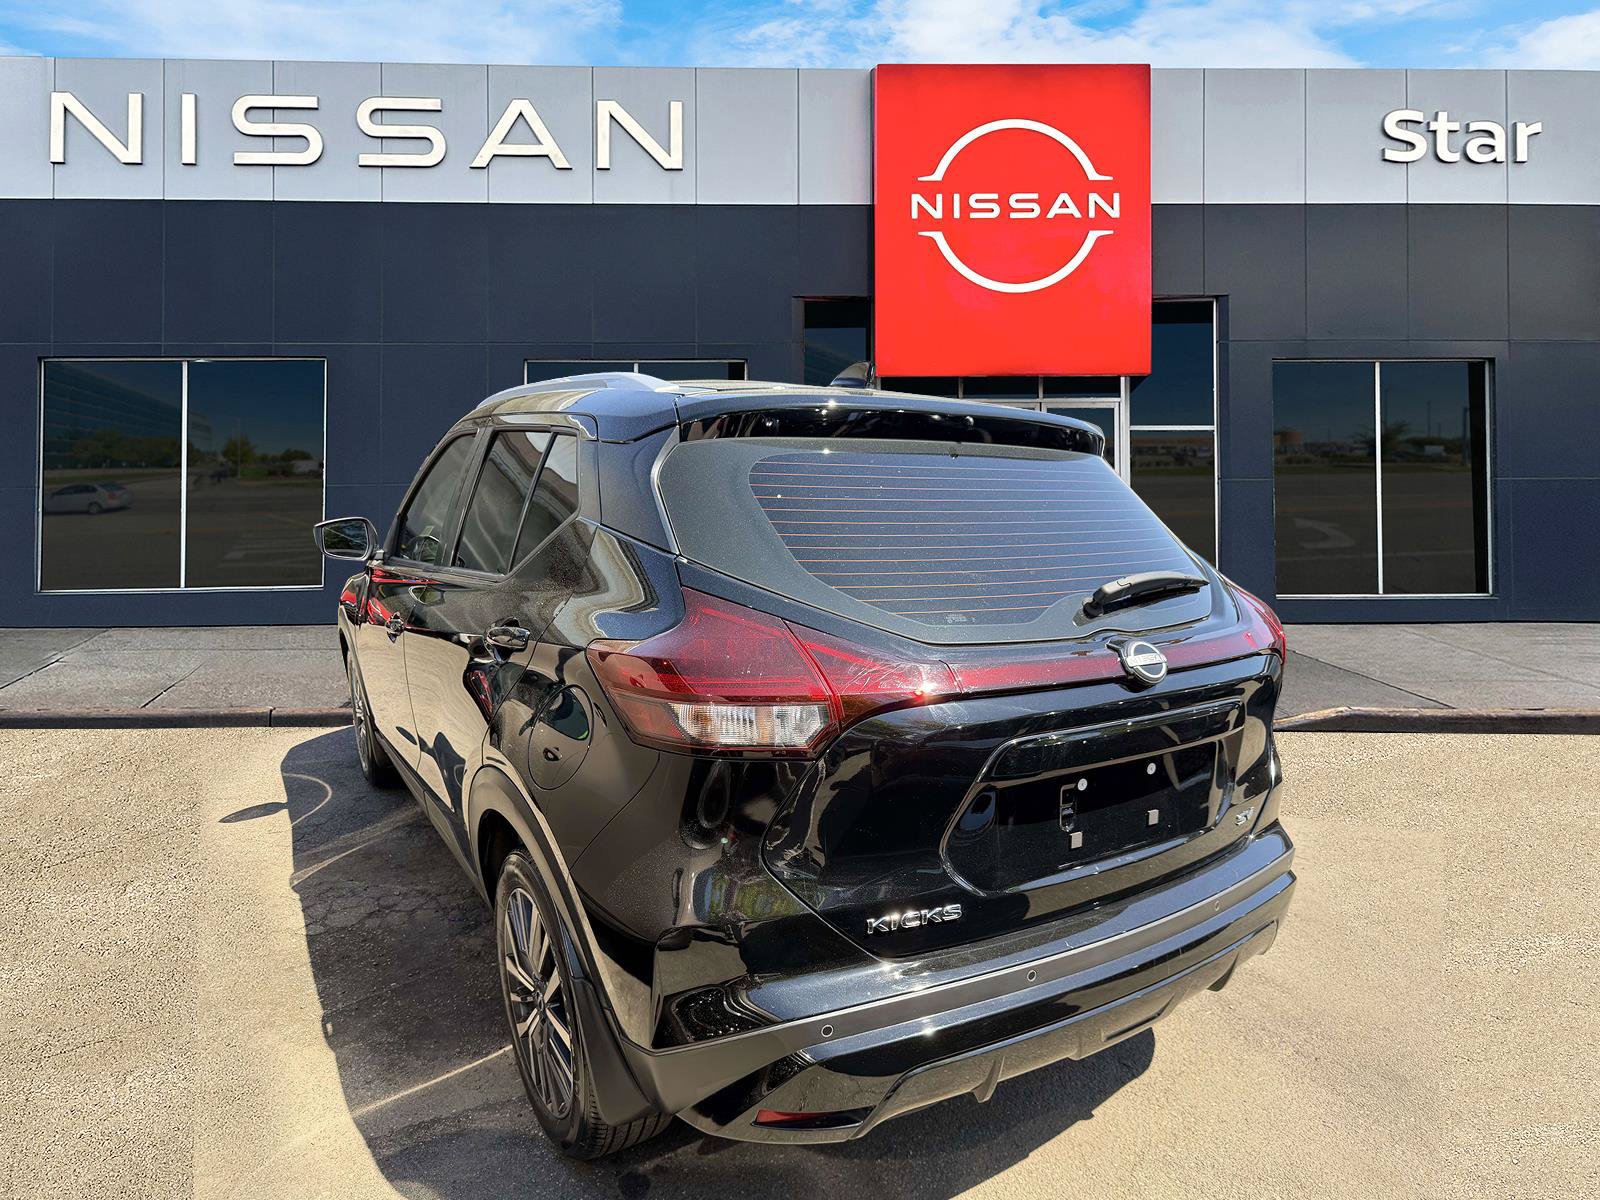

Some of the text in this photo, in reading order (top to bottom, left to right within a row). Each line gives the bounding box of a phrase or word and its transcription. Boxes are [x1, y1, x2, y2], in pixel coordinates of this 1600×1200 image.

[50, 91, 684, 170] NISSAN
[1382, 109, 1543, 164] Star
[910, 192, 1121, 219] NISSAN
[866, 903, 963, 934] KICKS
